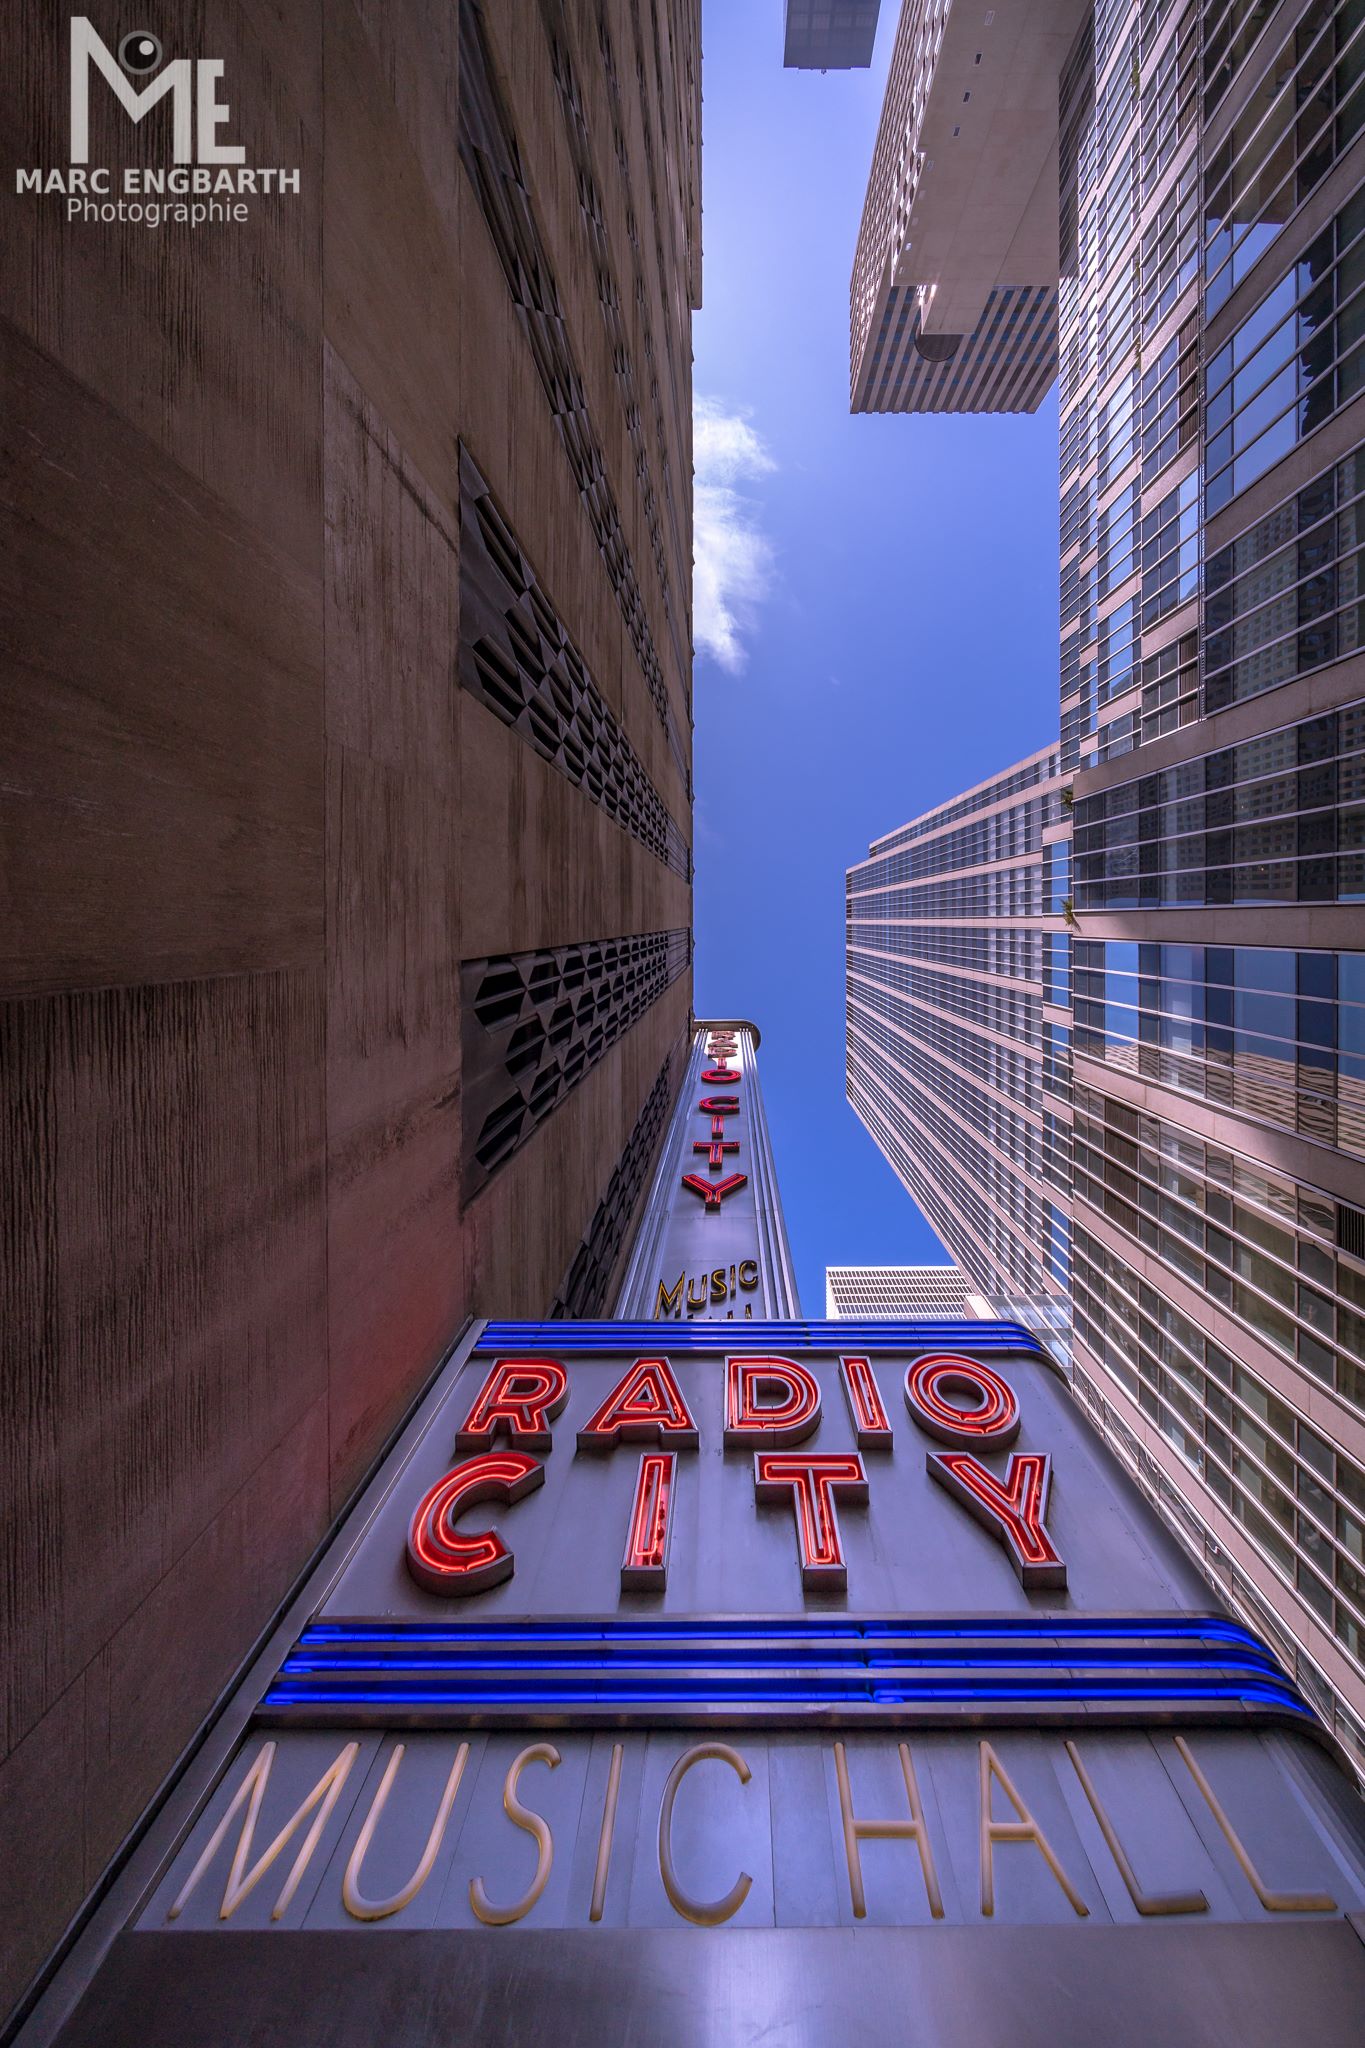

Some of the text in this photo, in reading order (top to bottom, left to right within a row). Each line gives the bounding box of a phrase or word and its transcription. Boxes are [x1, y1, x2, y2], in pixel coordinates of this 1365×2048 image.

[682, 1096, 748, 1211] CITY
[655, 1260, 758, 1319] MUSIC
[455, 1352, 1020, 1452] RADIO
[406, 1451, 1068, 1598] CITY
[166, 1734, 1337, 1926] MUSIC HALL
